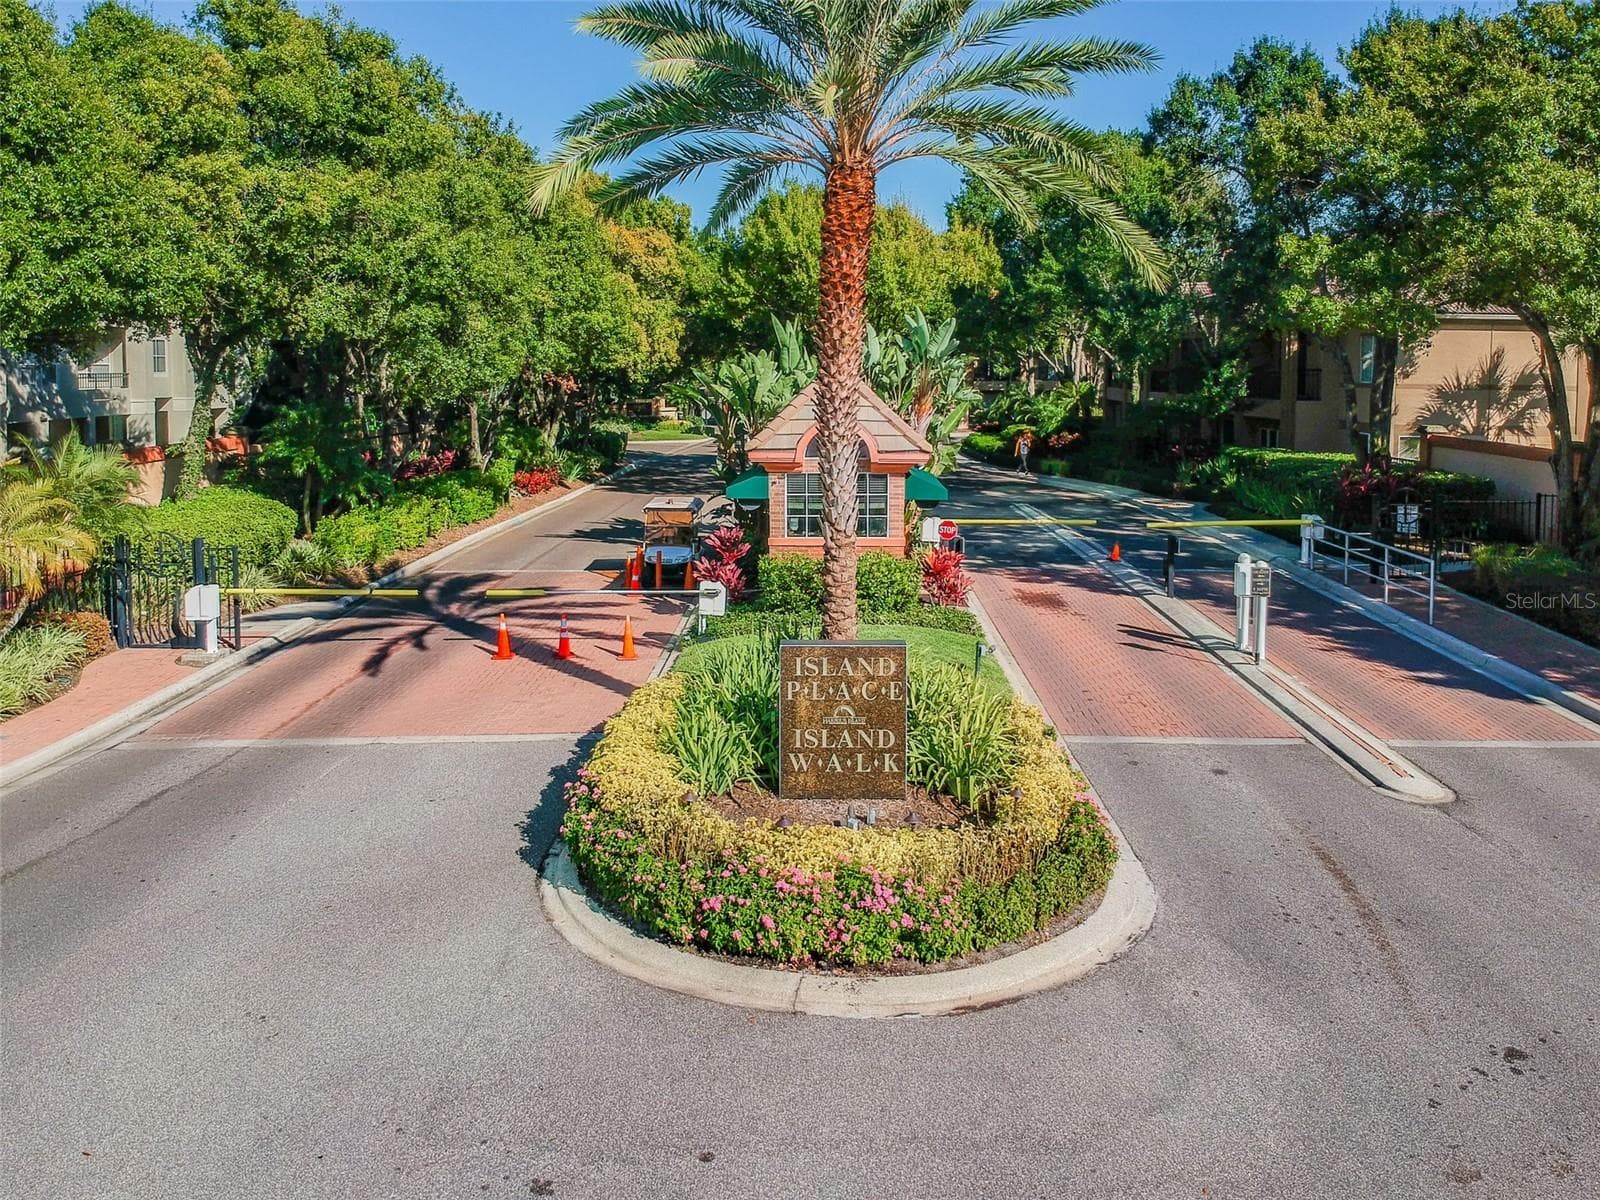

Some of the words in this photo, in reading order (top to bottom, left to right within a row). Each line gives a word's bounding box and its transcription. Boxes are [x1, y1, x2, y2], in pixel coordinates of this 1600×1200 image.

[939, 525, 956, 534] STOP
[794, 656, 898, 677] ISLAND
[791, 728, 897, 749] ISLAND
